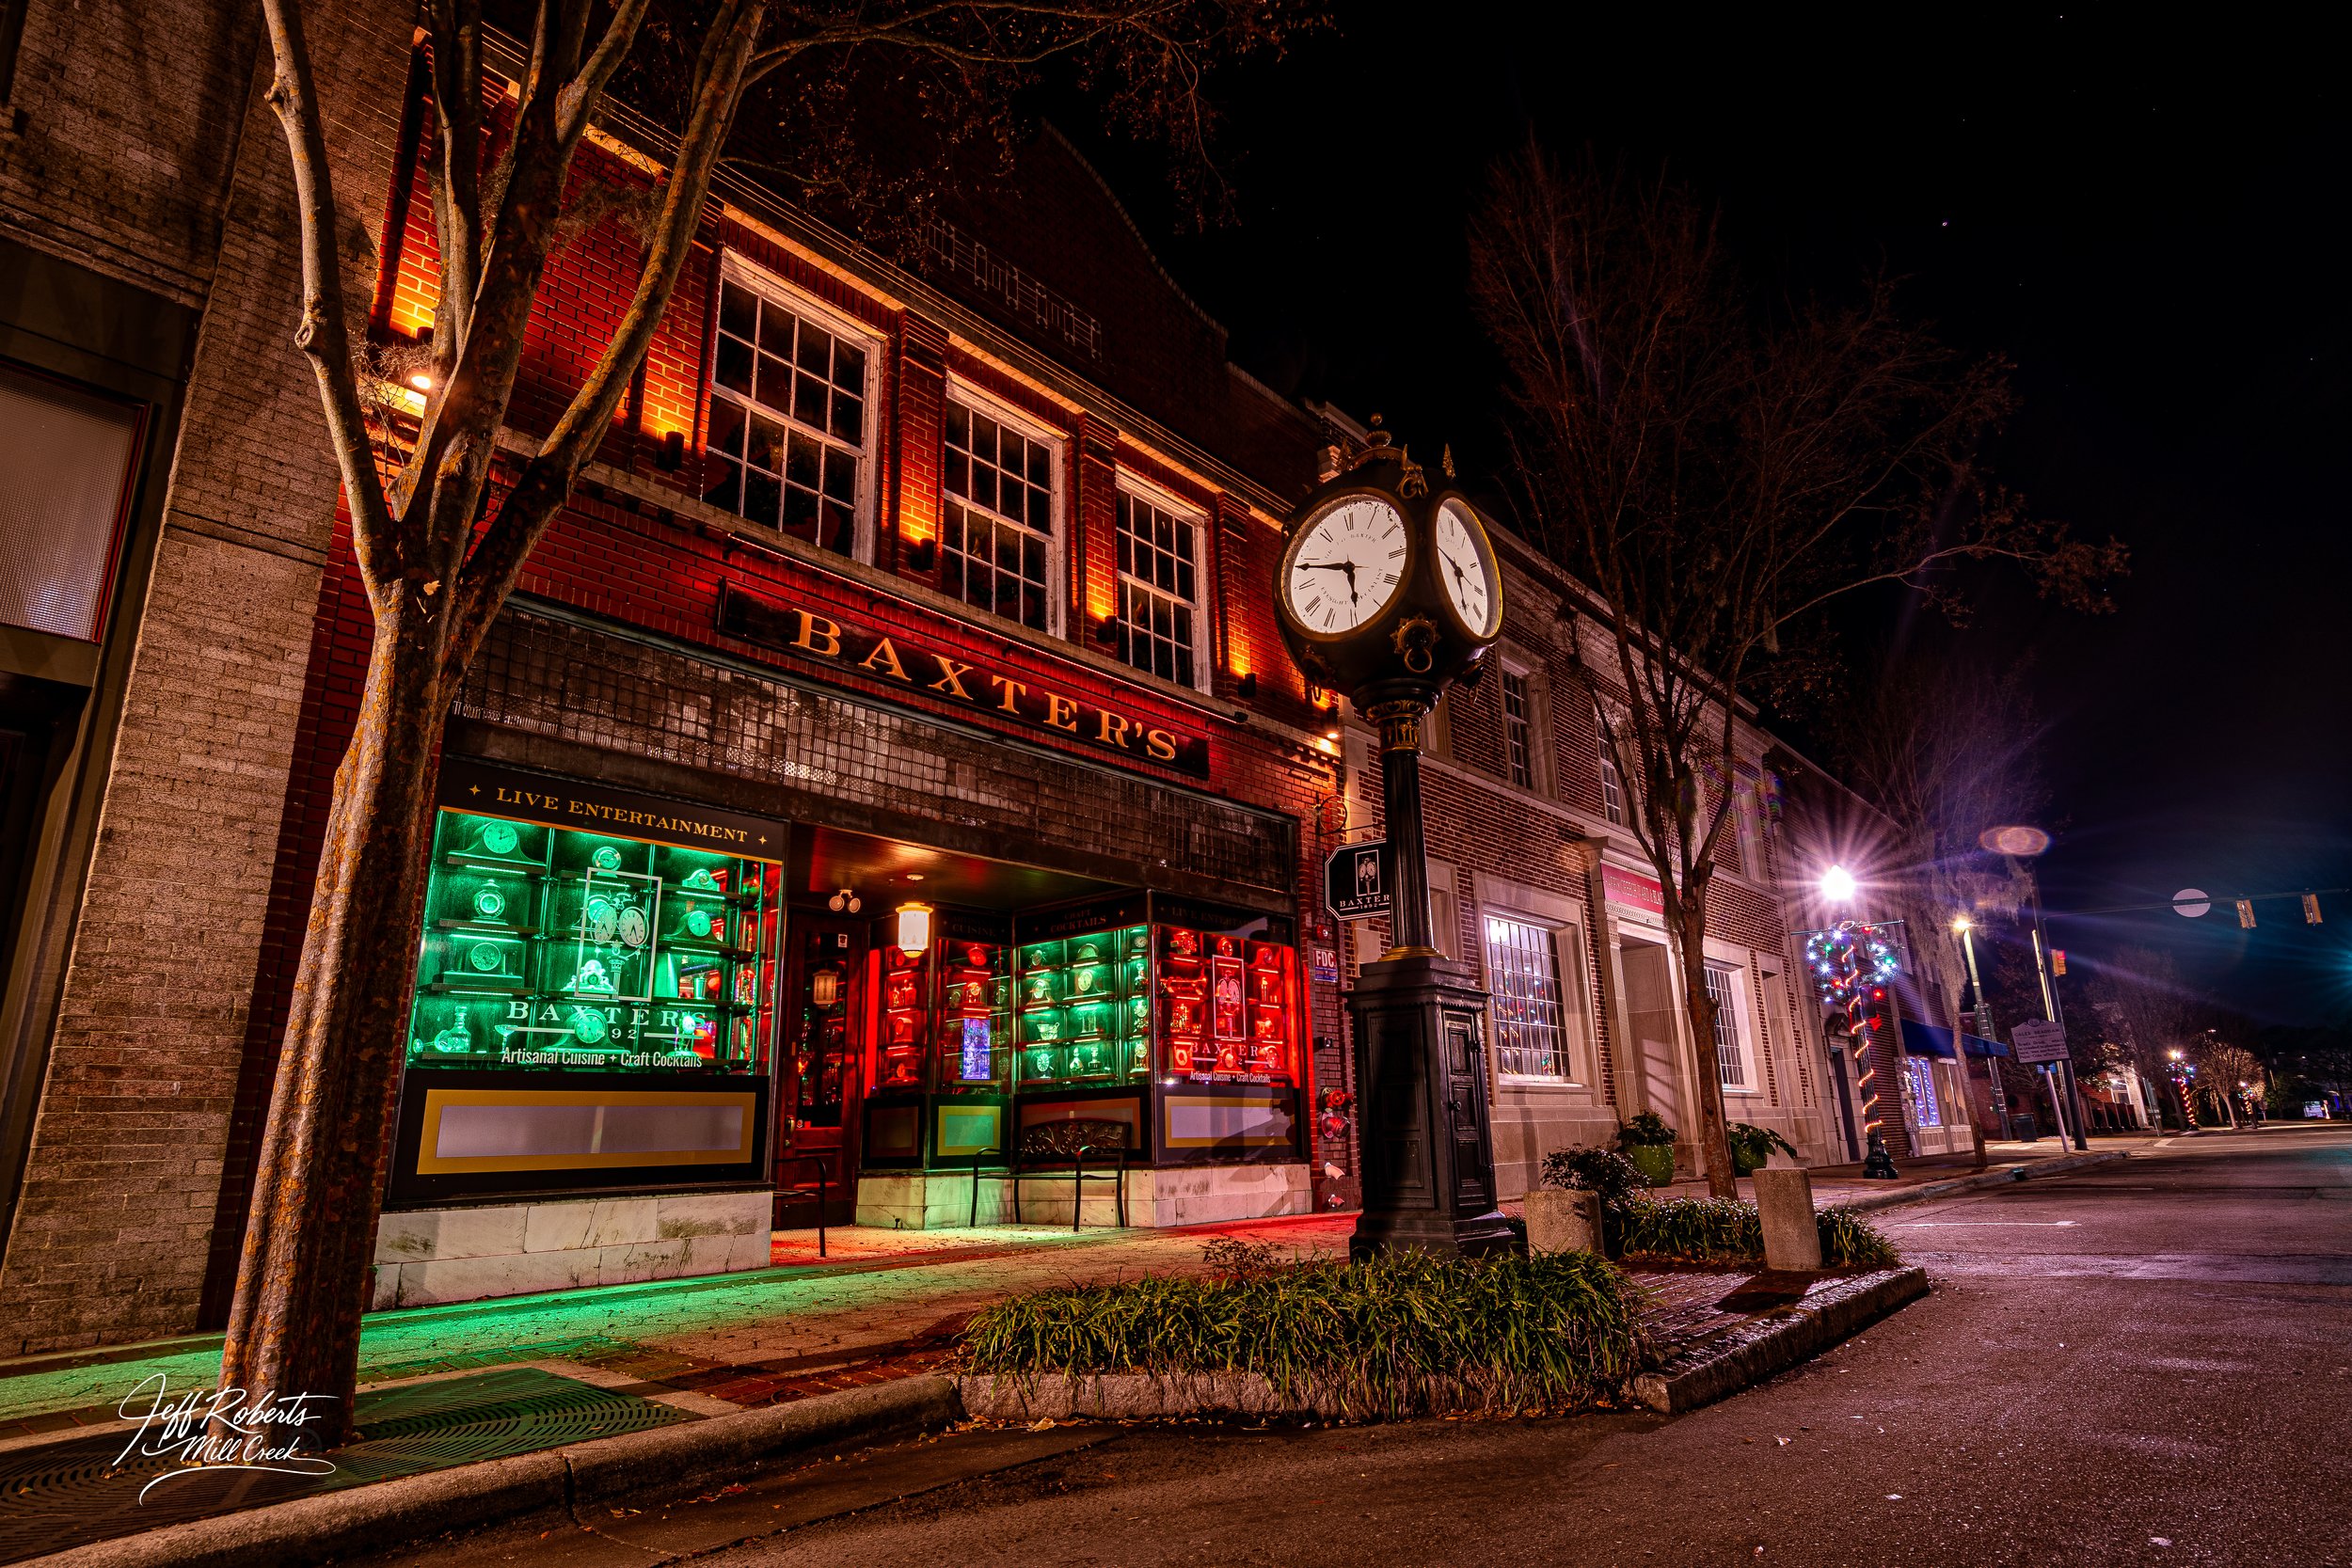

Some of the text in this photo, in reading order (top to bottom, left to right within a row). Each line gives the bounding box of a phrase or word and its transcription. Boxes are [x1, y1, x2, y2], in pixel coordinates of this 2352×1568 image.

[1357, 567, 1384, 601] PECIALIST
[788, 607, 1178, 761] BAXTER'S
[496, 787, 749, 844] LIVE ENTERTAINMENT
[1050, 915, 1107, 934] COCKTAILS
[1171, 906, 1278, 934] LIVE ENTERTAT
[1315, 950, 1334, 968] FDC
[506, 1001, 707, 1028] BAXTERS
[501, 1046, 703, 1068] Artisanal Cuisine Craft Cocktails
[1190, 1041, 1268, 1057] BAXTER'
[1189, 1070, 1271, 1084] Artisanal Cuisine Craft Cocktails
